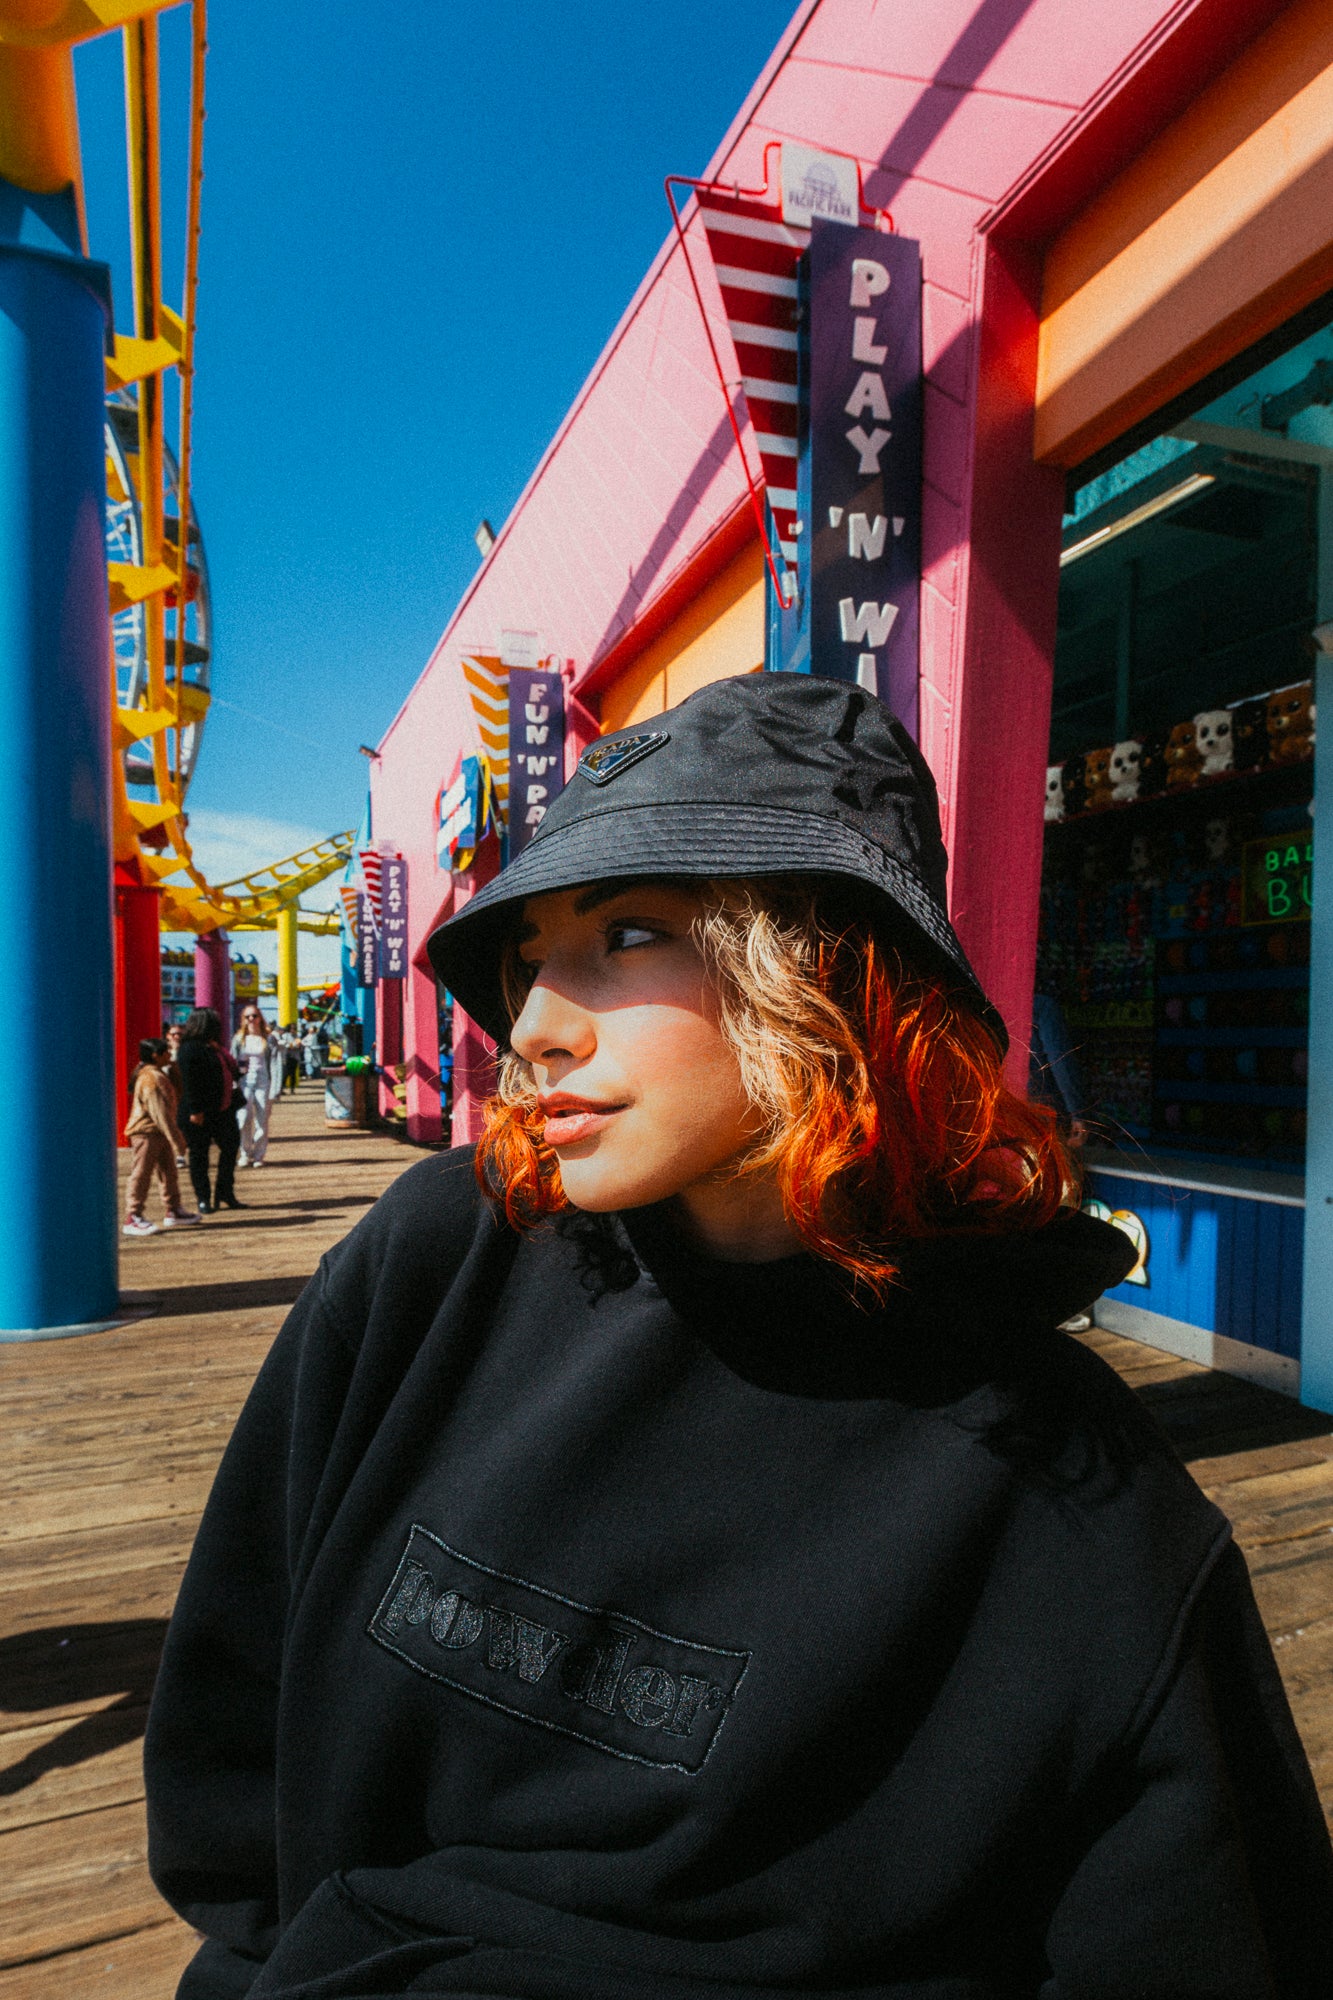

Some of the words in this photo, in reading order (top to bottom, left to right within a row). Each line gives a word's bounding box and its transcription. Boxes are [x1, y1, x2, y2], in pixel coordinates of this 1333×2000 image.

[844, 258, 893, 474] PLAY
[524, 683, 550, 745] FUN
[588, 737, 641, 762] PRADA
[524, 784, 548, 837] PR
[388, 866, 402, 913] PLAY
[387, 937, 403, 972] WIN
[379, 1559, 721, 1738] powder
